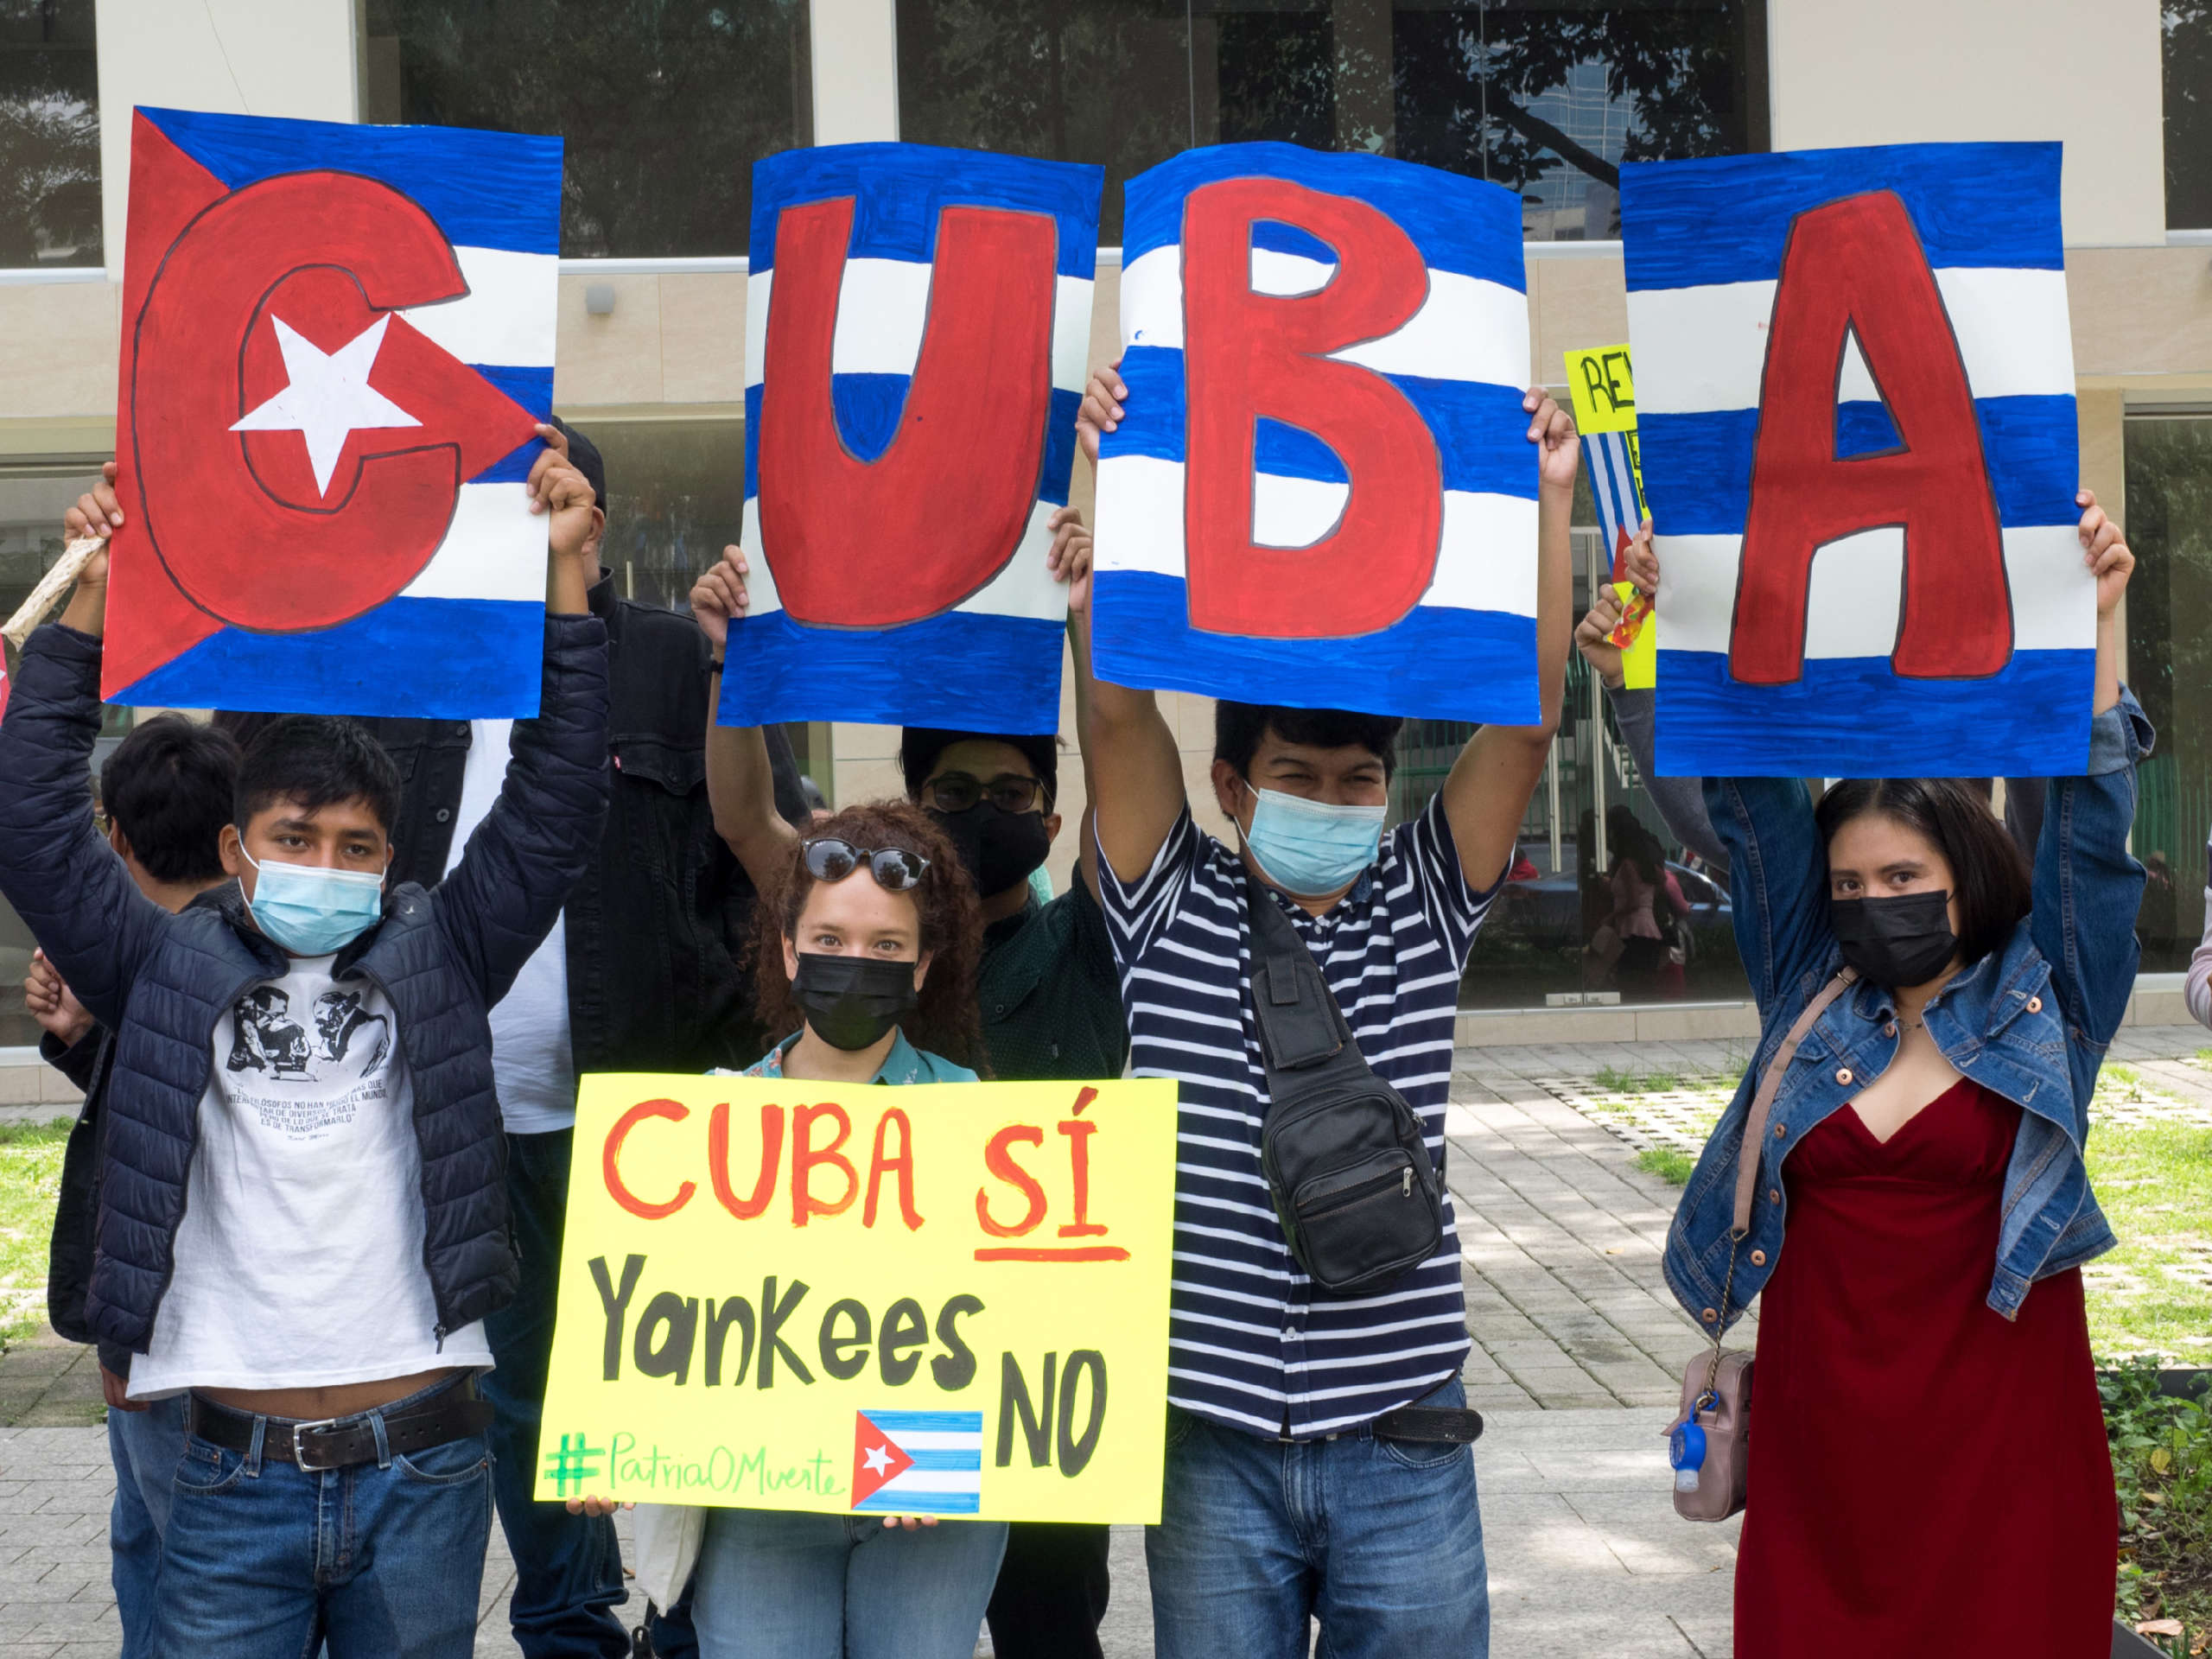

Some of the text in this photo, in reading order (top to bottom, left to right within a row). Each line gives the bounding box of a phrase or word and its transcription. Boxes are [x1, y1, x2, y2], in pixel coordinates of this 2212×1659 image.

[601, 1086, 1109, 1238] CUBA SÍ
[995, 1349, 1109, 1478] NO
